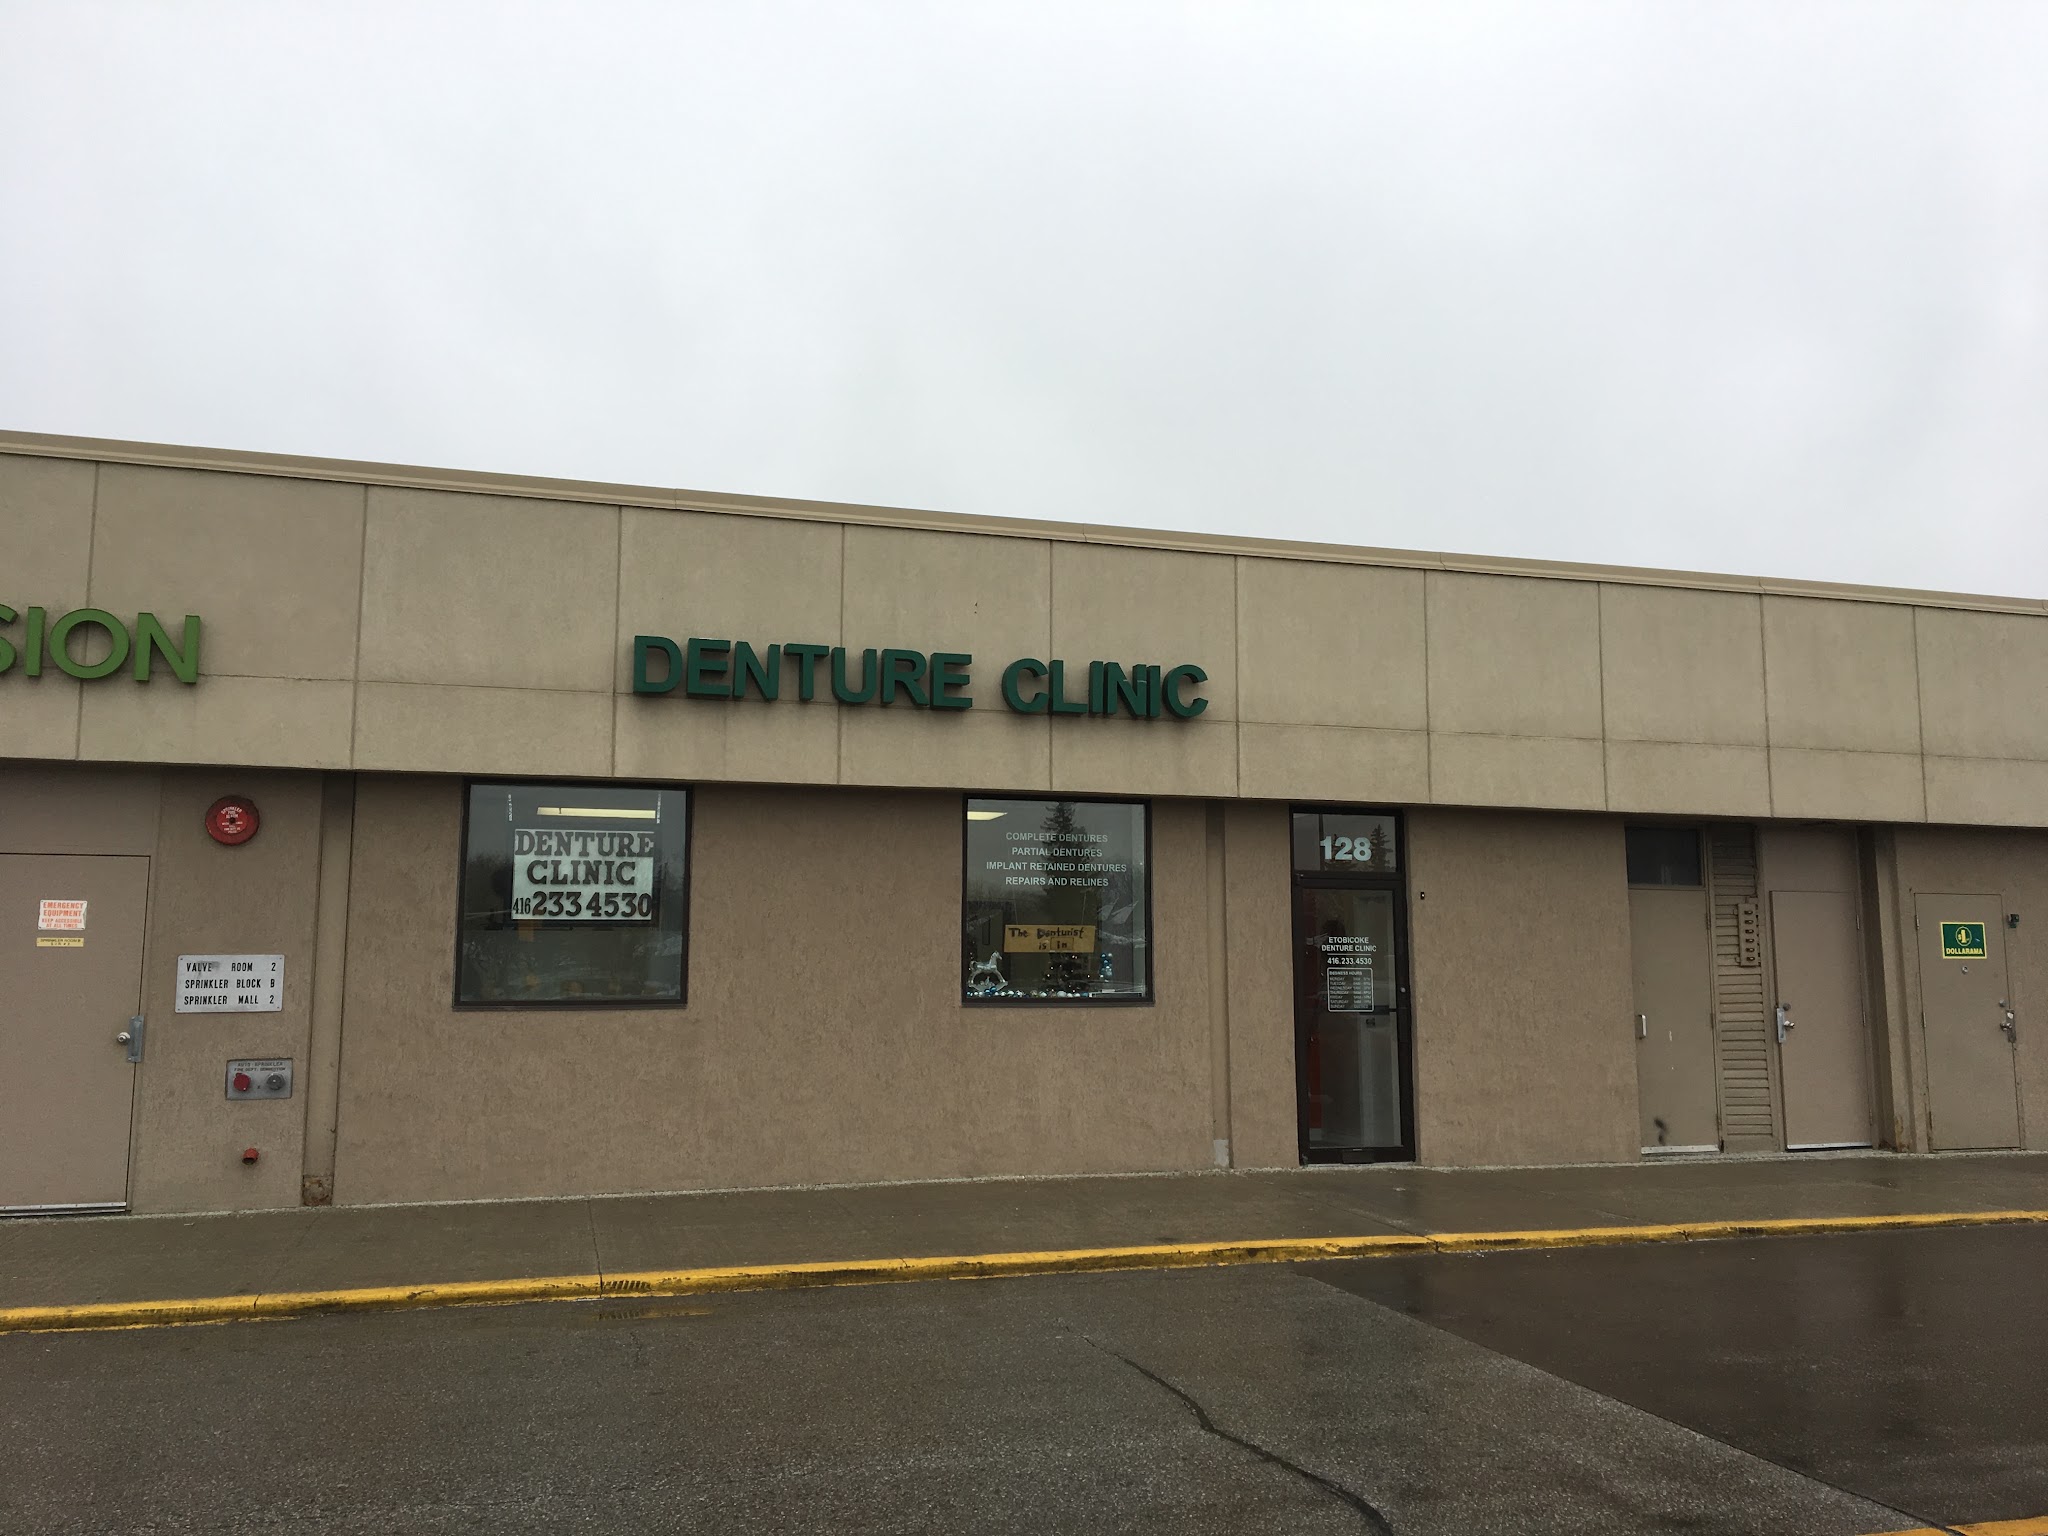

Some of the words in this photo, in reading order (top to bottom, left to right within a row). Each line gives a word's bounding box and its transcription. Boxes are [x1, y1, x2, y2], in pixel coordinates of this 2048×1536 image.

[633, 635, 973, 710] DENTURE
[1001, 658, 1209, 719] CLINIC
[1005, 832, 1057, 842] COMPLETE
[1059, 833, 1108, 843] DENTURES
[514, 830, 654, 857] DENTURE
[1319, 835, 1372, 861] 128
[1012, 847, 1051, 856] PARTIAL
[1053, 848, 1103, 857] DENTURES
[526, 859, 636, 885] CLINIC
[986, 861, 1028, 871] IMPLANT
[1029, 862, 1076, 872] RETAINED
[1078, 863, 1127, 873] DENTURES
[1005, 876, 1046, 886] REPAIRS
[1047, 877, 1068, 886] AND
[1070, 878, 1109, 887] RELINES
[513, 897, 531, 915] 416
[532, 890, 582, 917] 233
[586, 891, 652, 917] 4530
[1008, 927, 1028, 938] The
[1036, 927, 1085, 939] Denturist
[1038, 941, 1047, 950] is
[1328, 936, 1370, 944] ETOBICOKE
[1321, 944, 1354, 952] DENTURE
[1945, 947, 1984, 955] DOLLARAMA
[1327, 957, 1372, 965] 416.233.4530
[186, 962, 212, 972] VALVE
[231, 962, 253, 972] ROOM
[271, 962, 276, 972] 2
[185, 979, 229, 989] SPRINKLER
[236, 978, 261, 988] BLOCK
[270, 978, 275, 988] B
[184, 995, 228, 1005] SPRINKLER
[238, 995, 259, 1005] MALL
[269, 994, 275, 1005] 2
